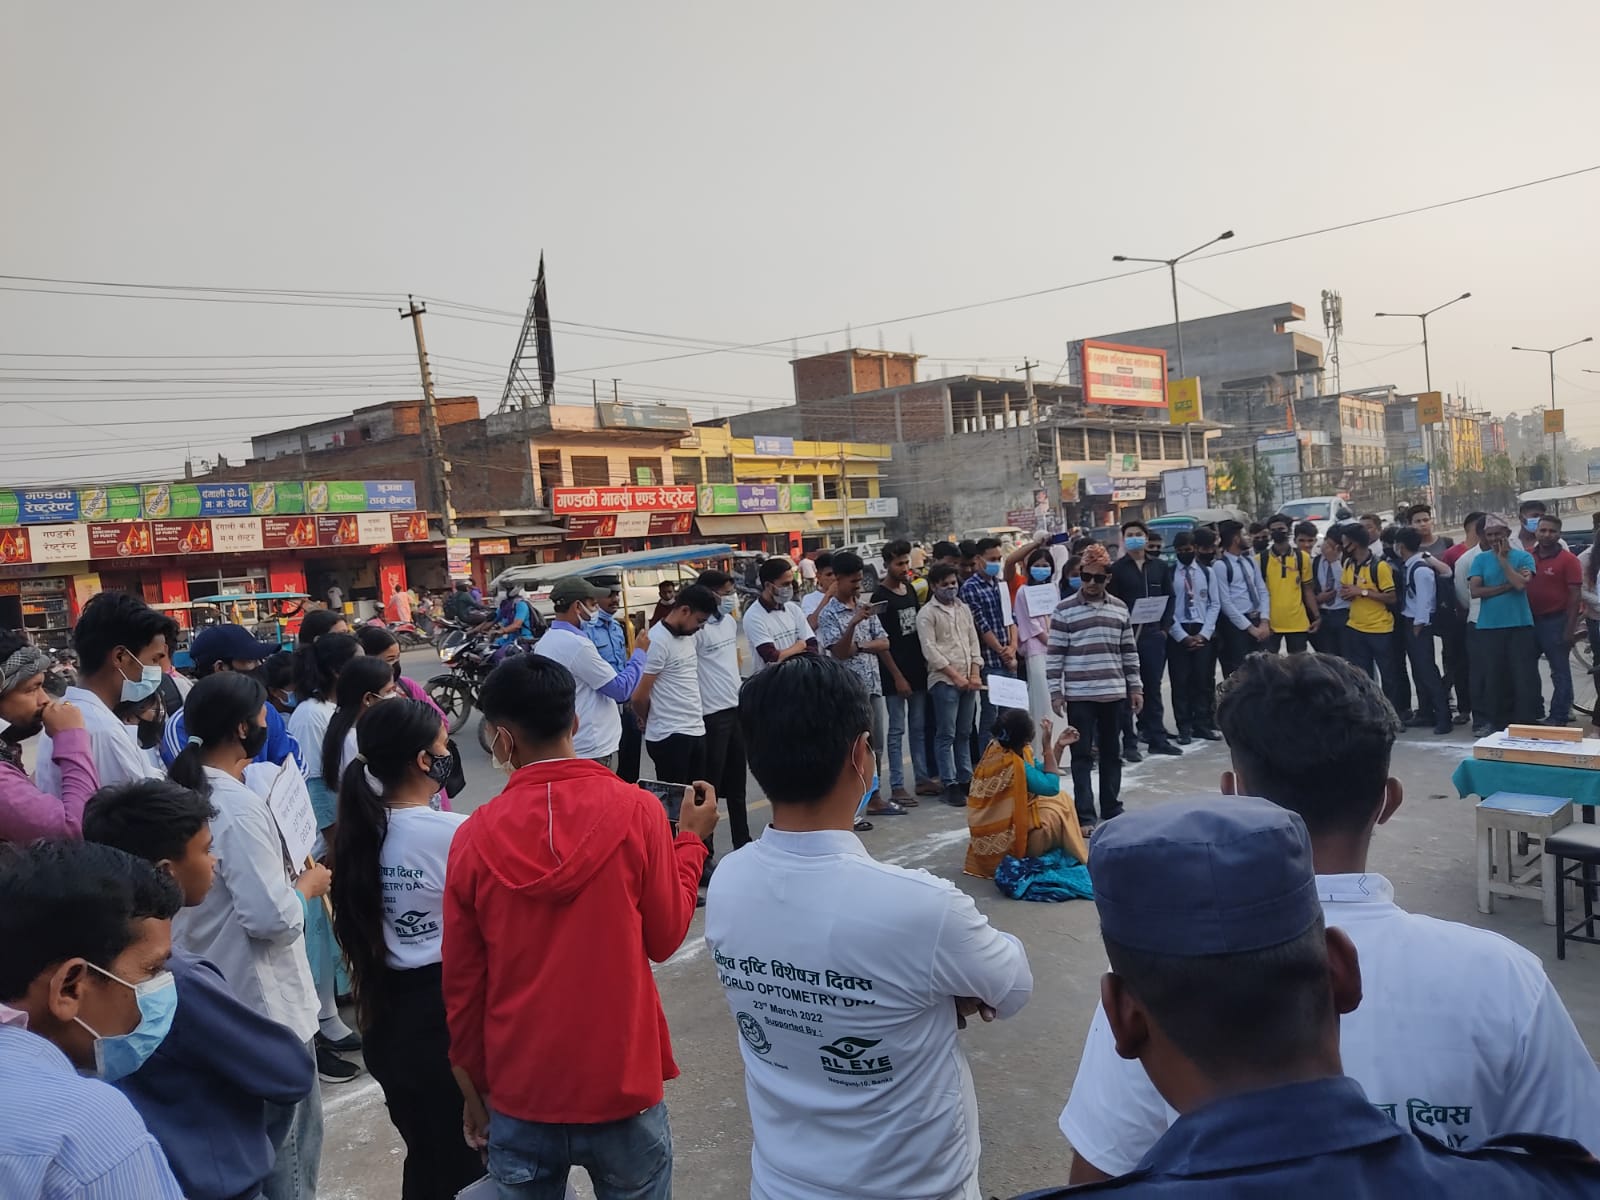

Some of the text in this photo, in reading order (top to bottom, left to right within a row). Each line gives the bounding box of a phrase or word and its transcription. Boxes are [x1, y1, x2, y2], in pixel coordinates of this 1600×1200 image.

[556, 489, 598, 508] गण्डकी
[635, 492, 657, 506] एण्ड
[397, 865, 424, 879] दिवस
[411, 920, 438, 933] EYE
[738, 956, 767, 977] दृष्टि
[771, 959, 821, 986] विशेषज्ञ
[825, 969, 873, 991] दिवस
[757, 982, 838, 1007] OPTOMETRY
[769, 1003, 799, 1018] March
[799, 1010, 824, 1024] 2022
[763, 1016, 805, 1034] Supported
[820, 1055, 891, 1070] RL EYE
[1406, 1098, 1472, 1127] दिवस
